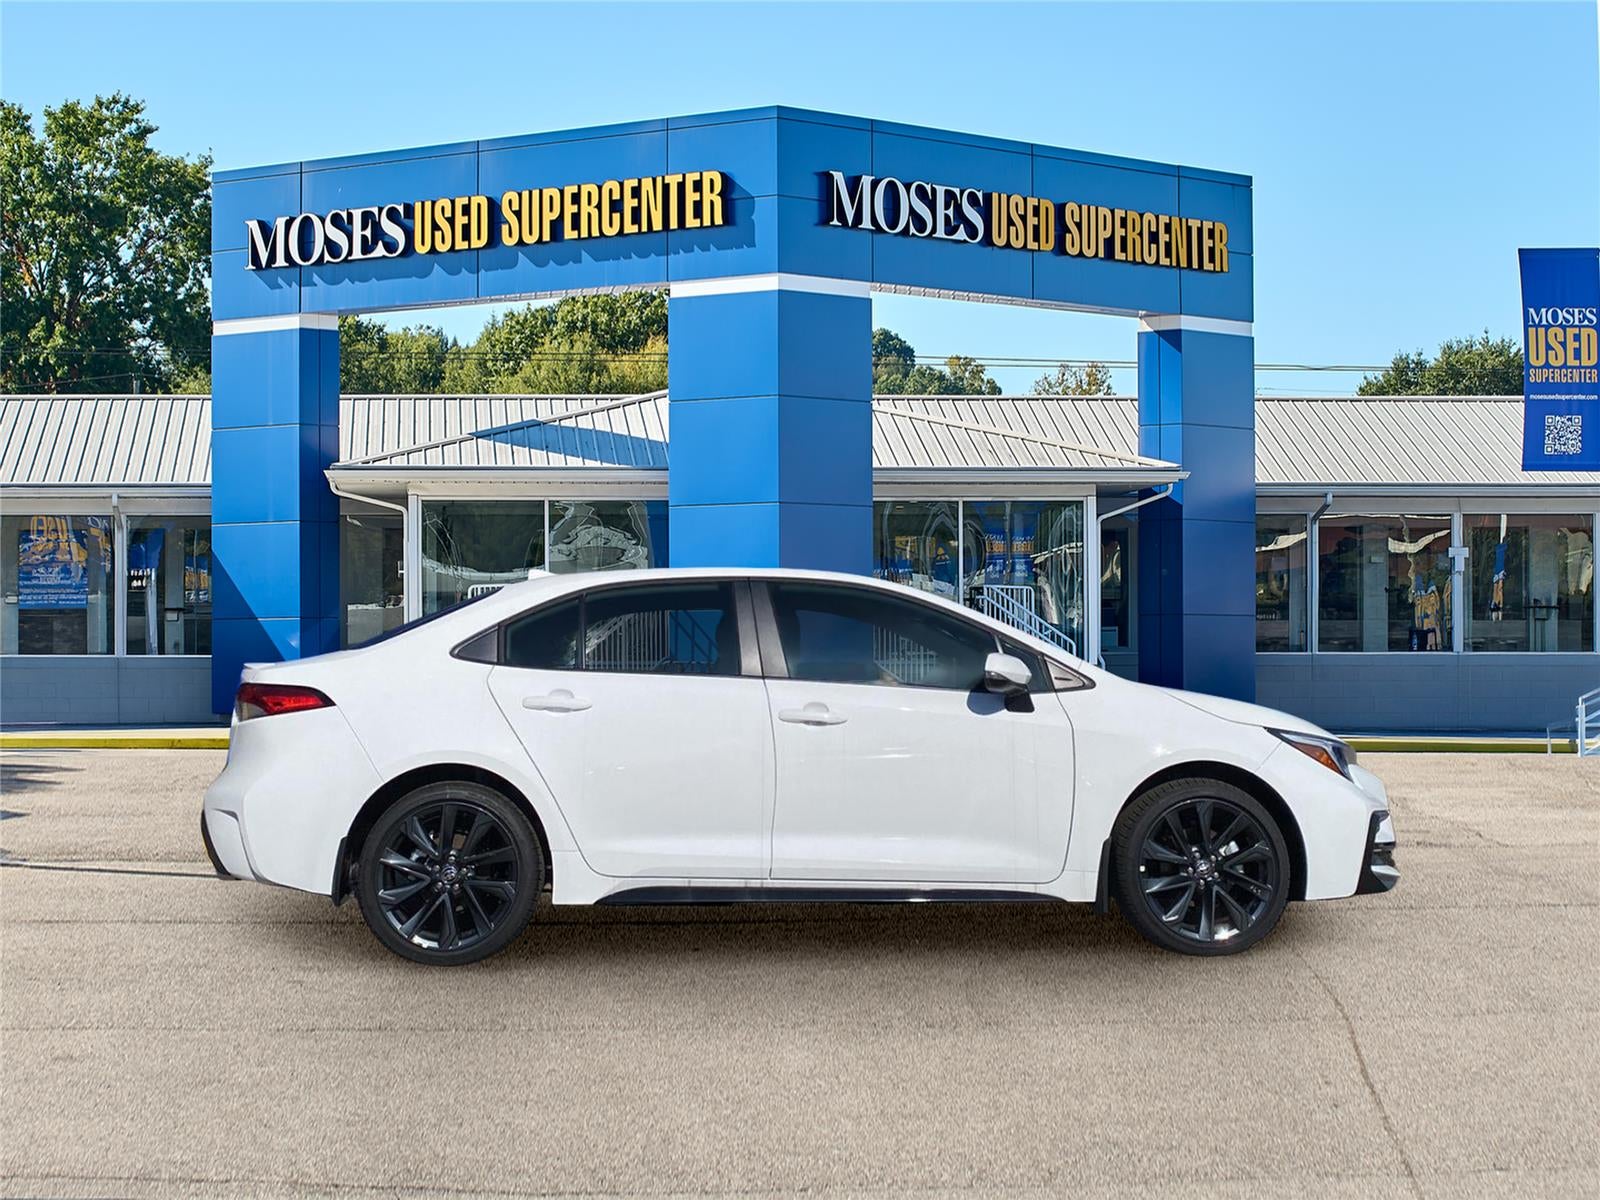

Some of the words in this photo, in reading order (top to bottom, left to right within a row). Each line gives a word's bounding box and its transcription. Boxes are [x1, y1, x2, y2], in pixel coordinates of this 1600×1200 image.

[244, 204, 408, 270] MOSES
[413, 195, 490, 255] USED
[501, 170, 723, 247] SUPERCENTER
[829, 170, 984, 244] MOSES
[991, 192, 1055, 251] USED
[1065, 202, 1229, 273] SUPERCENTER
[1528, 307, 1597, 326] MOSES
[1528, 327, 1598, 367] USED
[1529, 368, 1598, 383] SUPERCENTER
[1529, 393, 1598, 401] mosesusedsupercenter.com
